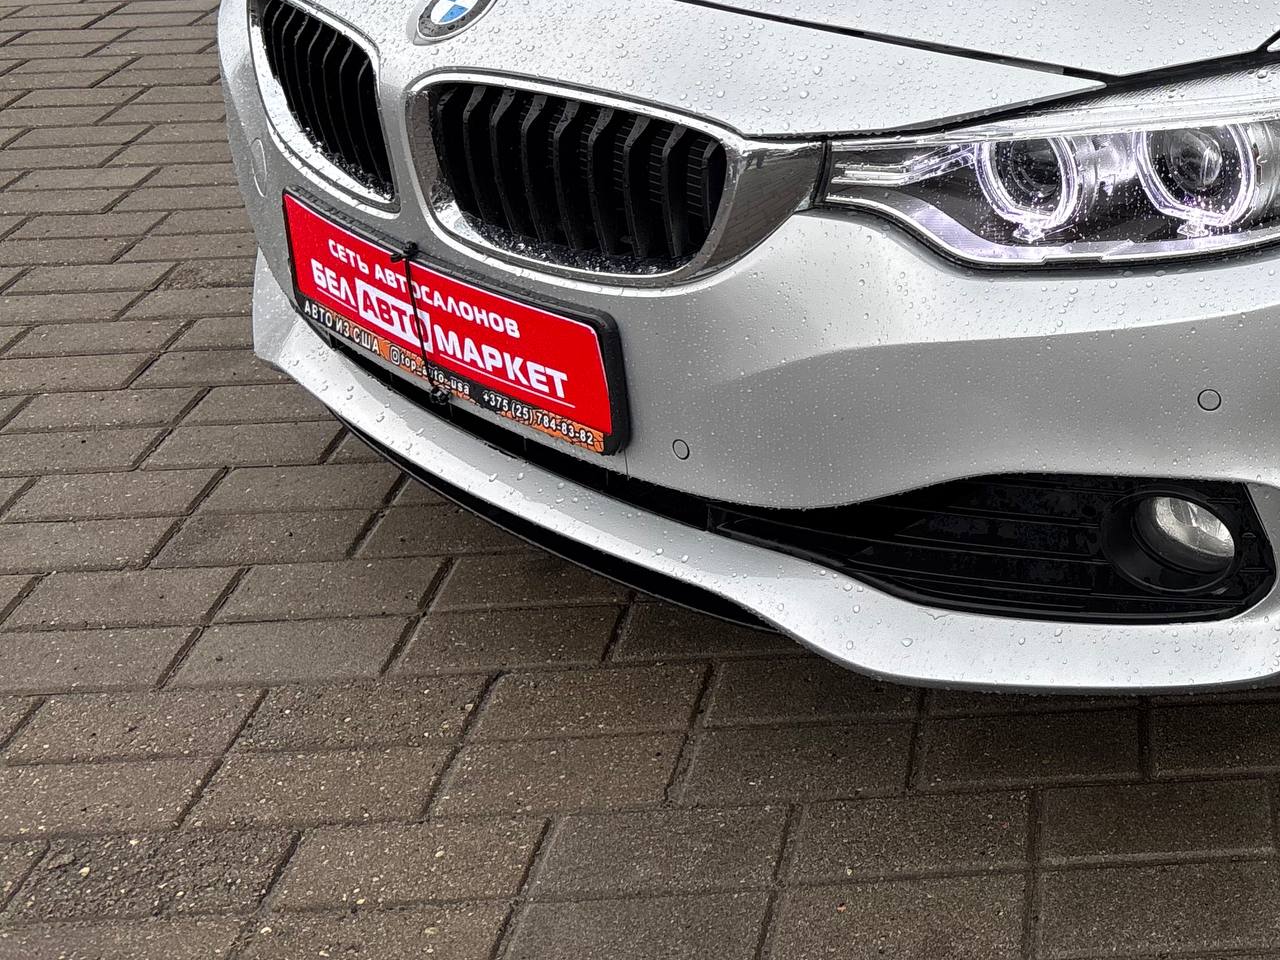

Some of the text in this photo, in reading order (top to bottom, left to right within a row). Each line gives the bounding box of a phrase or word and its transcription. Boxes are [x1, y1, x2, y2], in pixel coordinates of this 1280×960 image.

[328, 239, 369, 275] СЕТЬ
[304, 300, 381, 355] АВТО ИЗ США
[482, 391, 594, 445] +375 (25) 784-83-82
